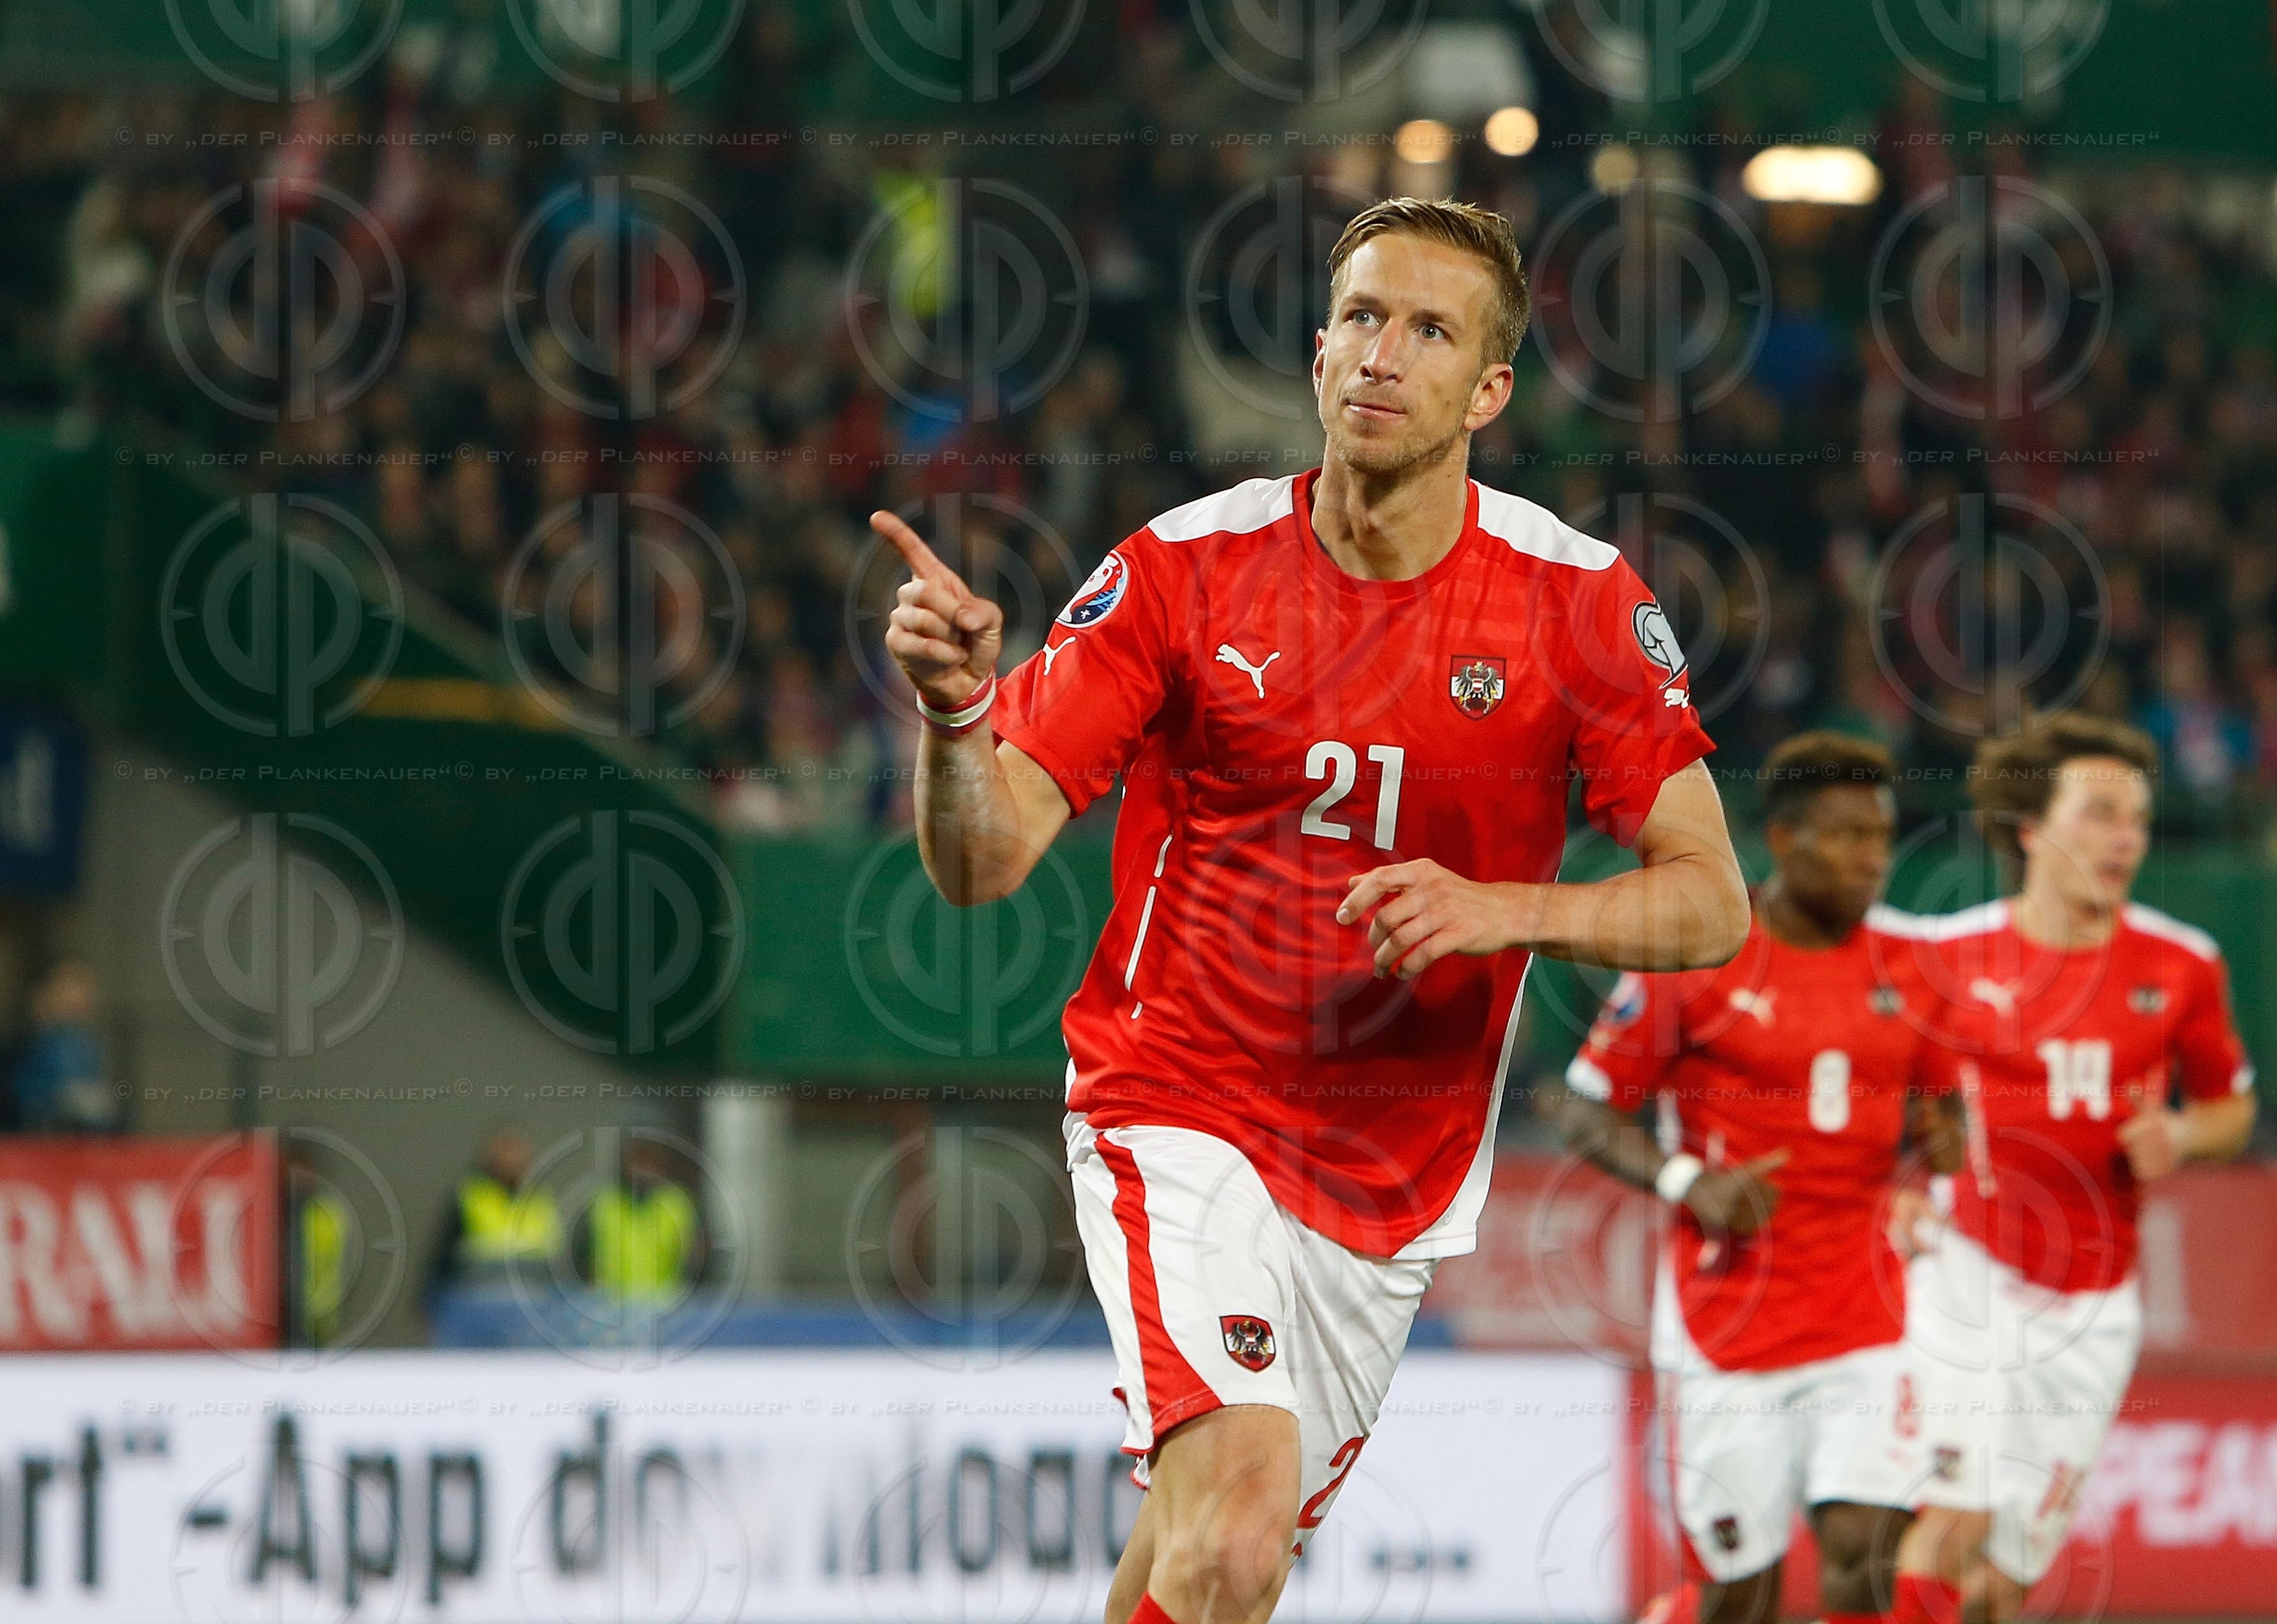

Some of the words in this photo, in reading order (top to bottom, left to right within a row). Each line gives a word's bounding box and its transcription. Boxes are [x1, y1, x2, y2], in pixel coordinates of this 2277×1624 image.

[1301, 741, 1405, 851] 21
[1809, 1048, 1852, 1134] 8
[2037, 1039, 2112, 1122] 14
